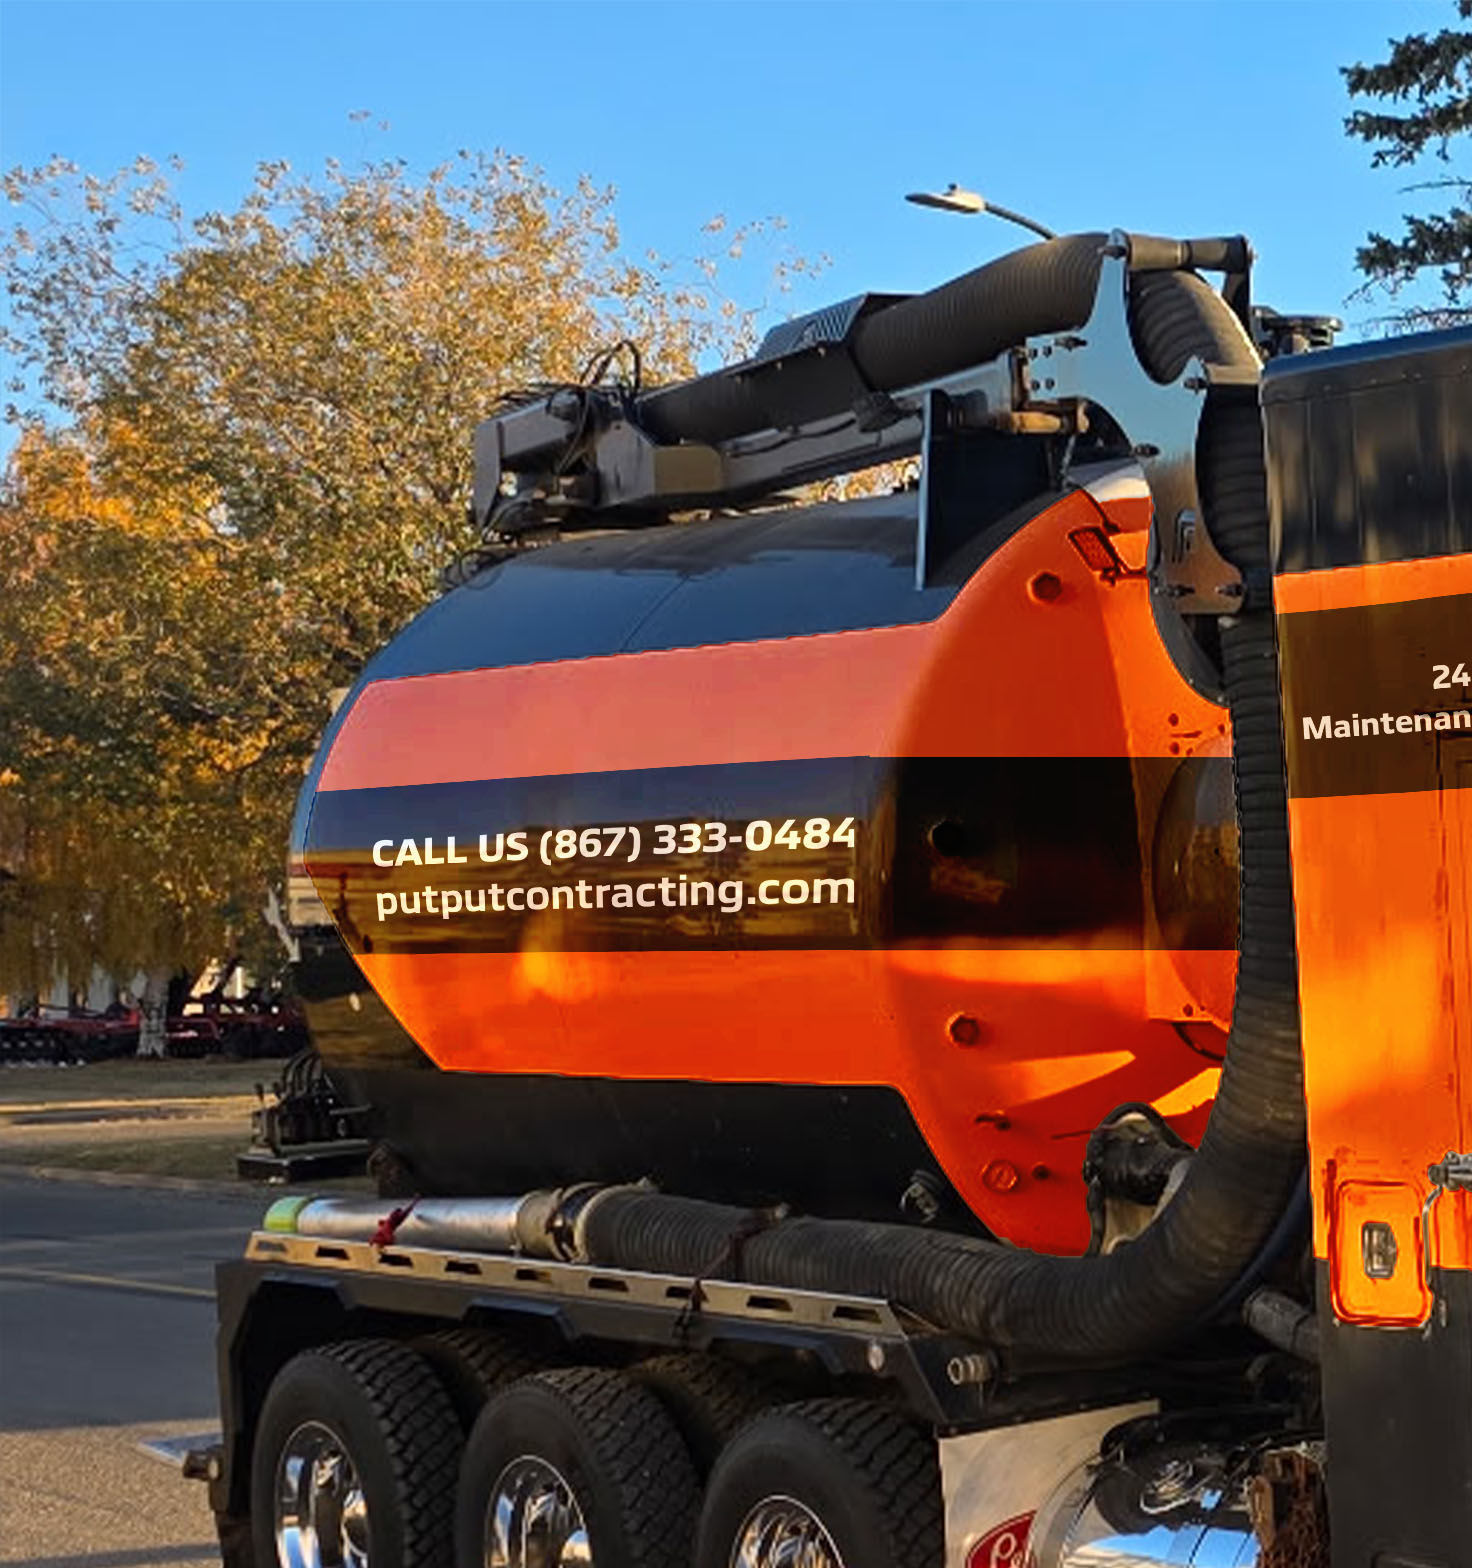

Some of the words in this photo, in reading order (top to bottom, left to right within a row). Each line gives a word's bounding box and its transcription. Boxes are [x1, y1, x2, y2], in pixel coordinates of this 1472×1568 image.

[1432, 662, 1472, 690] 24
[372, 836, 467, 867] CALL
[478, 832, 529, 862] US
[539, 826, 641, 866] (867)
[653, 817, 855, 856] 333-0484
[376, 874, 855, 922] putputcontracting.com
